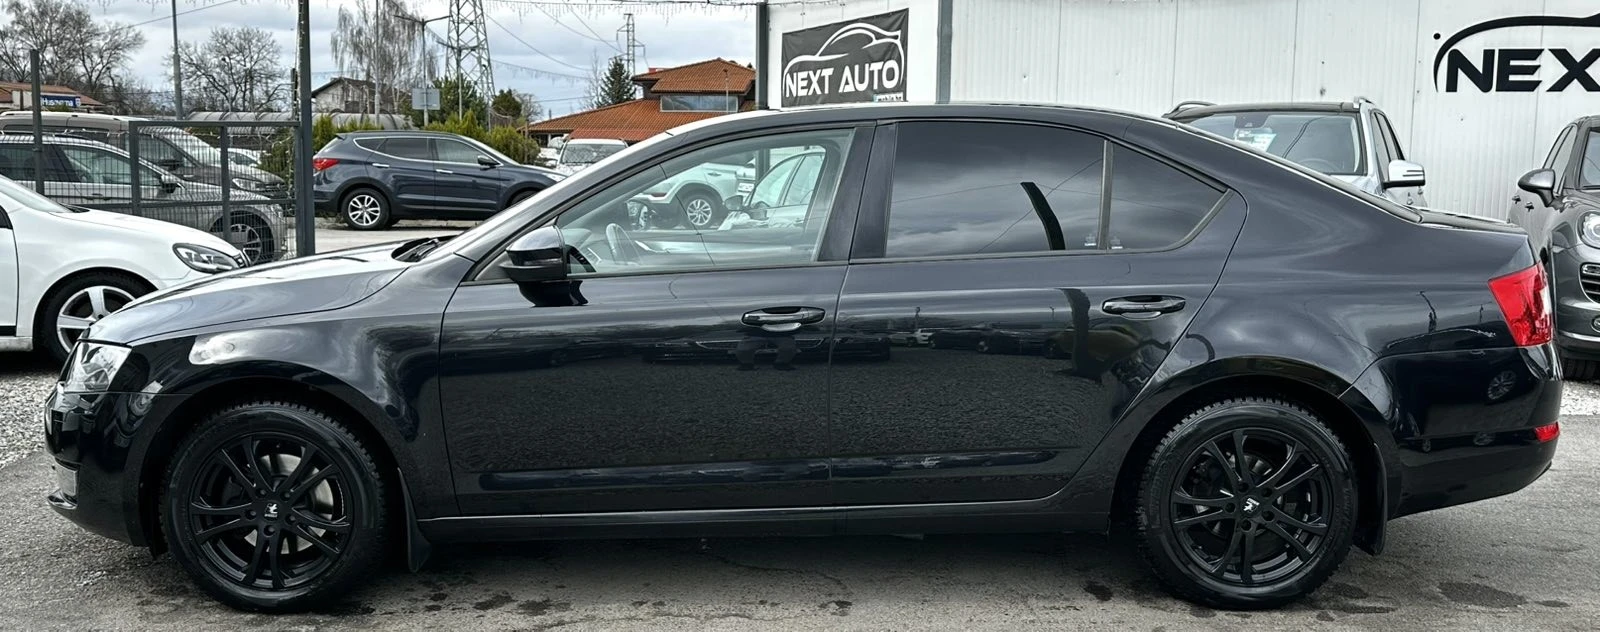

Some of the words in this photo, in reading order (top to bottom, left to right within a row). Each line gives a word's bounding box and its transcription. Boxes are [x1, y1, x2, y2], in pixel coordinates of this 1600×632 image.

[785, 67, 834, 98] NEXT
[838, 59, 899, 93] AUTO
[1446, 48, 1600, 93] NEX
